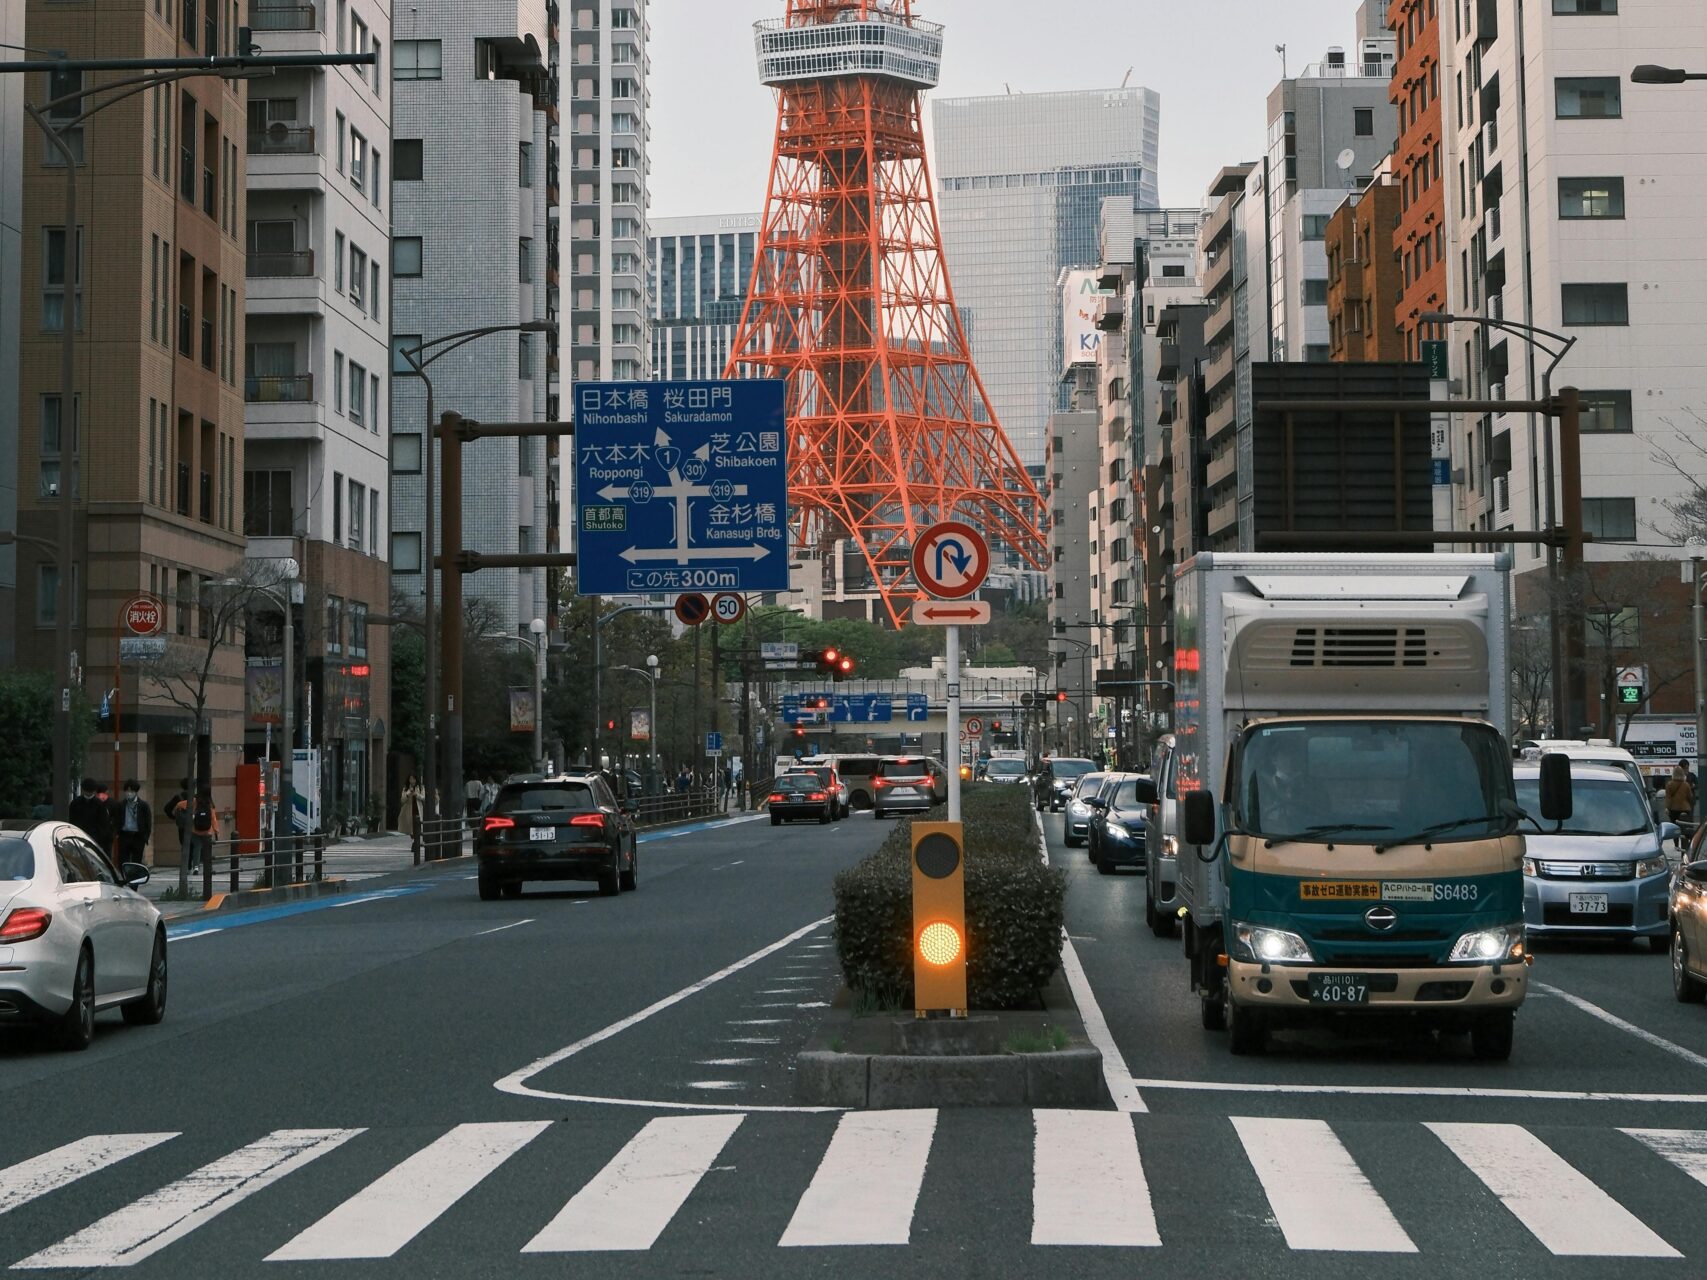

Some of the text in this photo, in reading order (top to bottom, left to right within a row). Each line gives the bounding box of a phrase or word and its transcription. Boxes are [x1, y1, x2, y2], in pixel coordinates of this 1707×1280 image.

[582, 387, 732, 410] 日本橋 桜田門
[583, 411, 732, 425] Nihonbashi Sakuradamon
[710, 431, 779, 454] 芝公園
[581, 443, 650, 465] 六本木
[664, 451, 671, 464] 1
[715, 456, 777, 468] Shibakoen
[589, 467, 643, 480] Roppongi
[686, 464, 703, 476] 301
[632, 486, 649, 498] 319
[714, 484, 731, 497] 319
[585, 507, 624, 521] 首都高
[708, 503, 776, 525] 金杉橋
[706, 526, 783, 540] Kanasugi Brdg.
[630, 570, 736, 587] この先300m
[718, 600, 737, 615] 50
[130, 611, 156, 623] 消火栓
[1303, 884, 1377, 897] 事故ゼロ運動実施中
[1434, 884, 1478, 900] S6483
[1322, 985, 1366, 1001] 60-87
